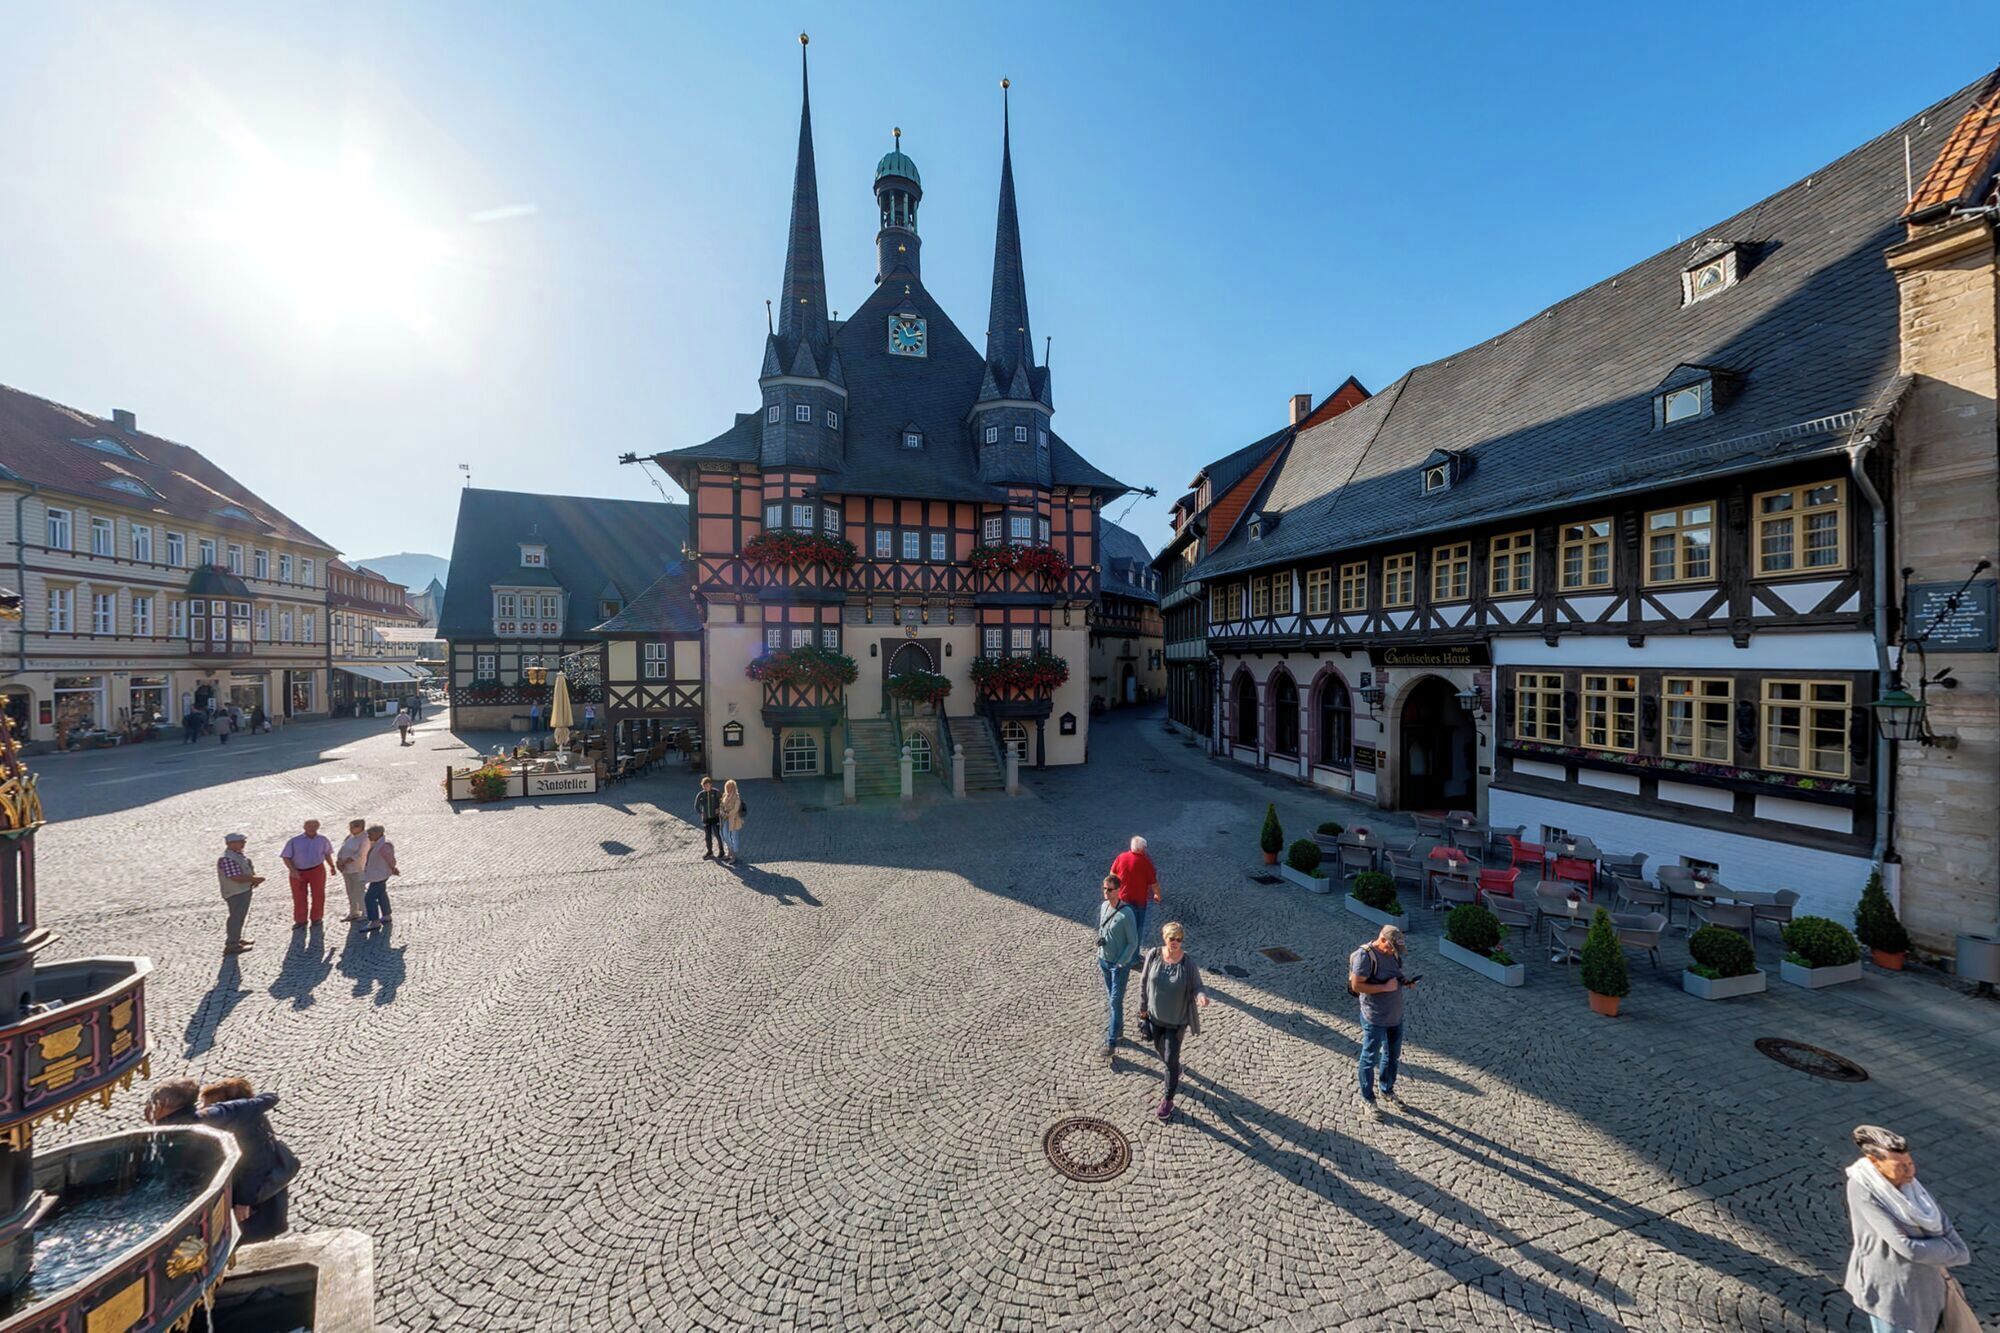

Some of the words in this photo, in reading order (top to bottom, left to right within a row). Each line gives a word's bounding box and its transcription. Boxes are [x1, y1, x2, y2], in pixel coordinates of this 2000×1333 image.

[1451, 646, 1469, 654] Hotel
[1443, 652, 1471, 664] Haus
[536, 778, 588, 792] Ratskeller
